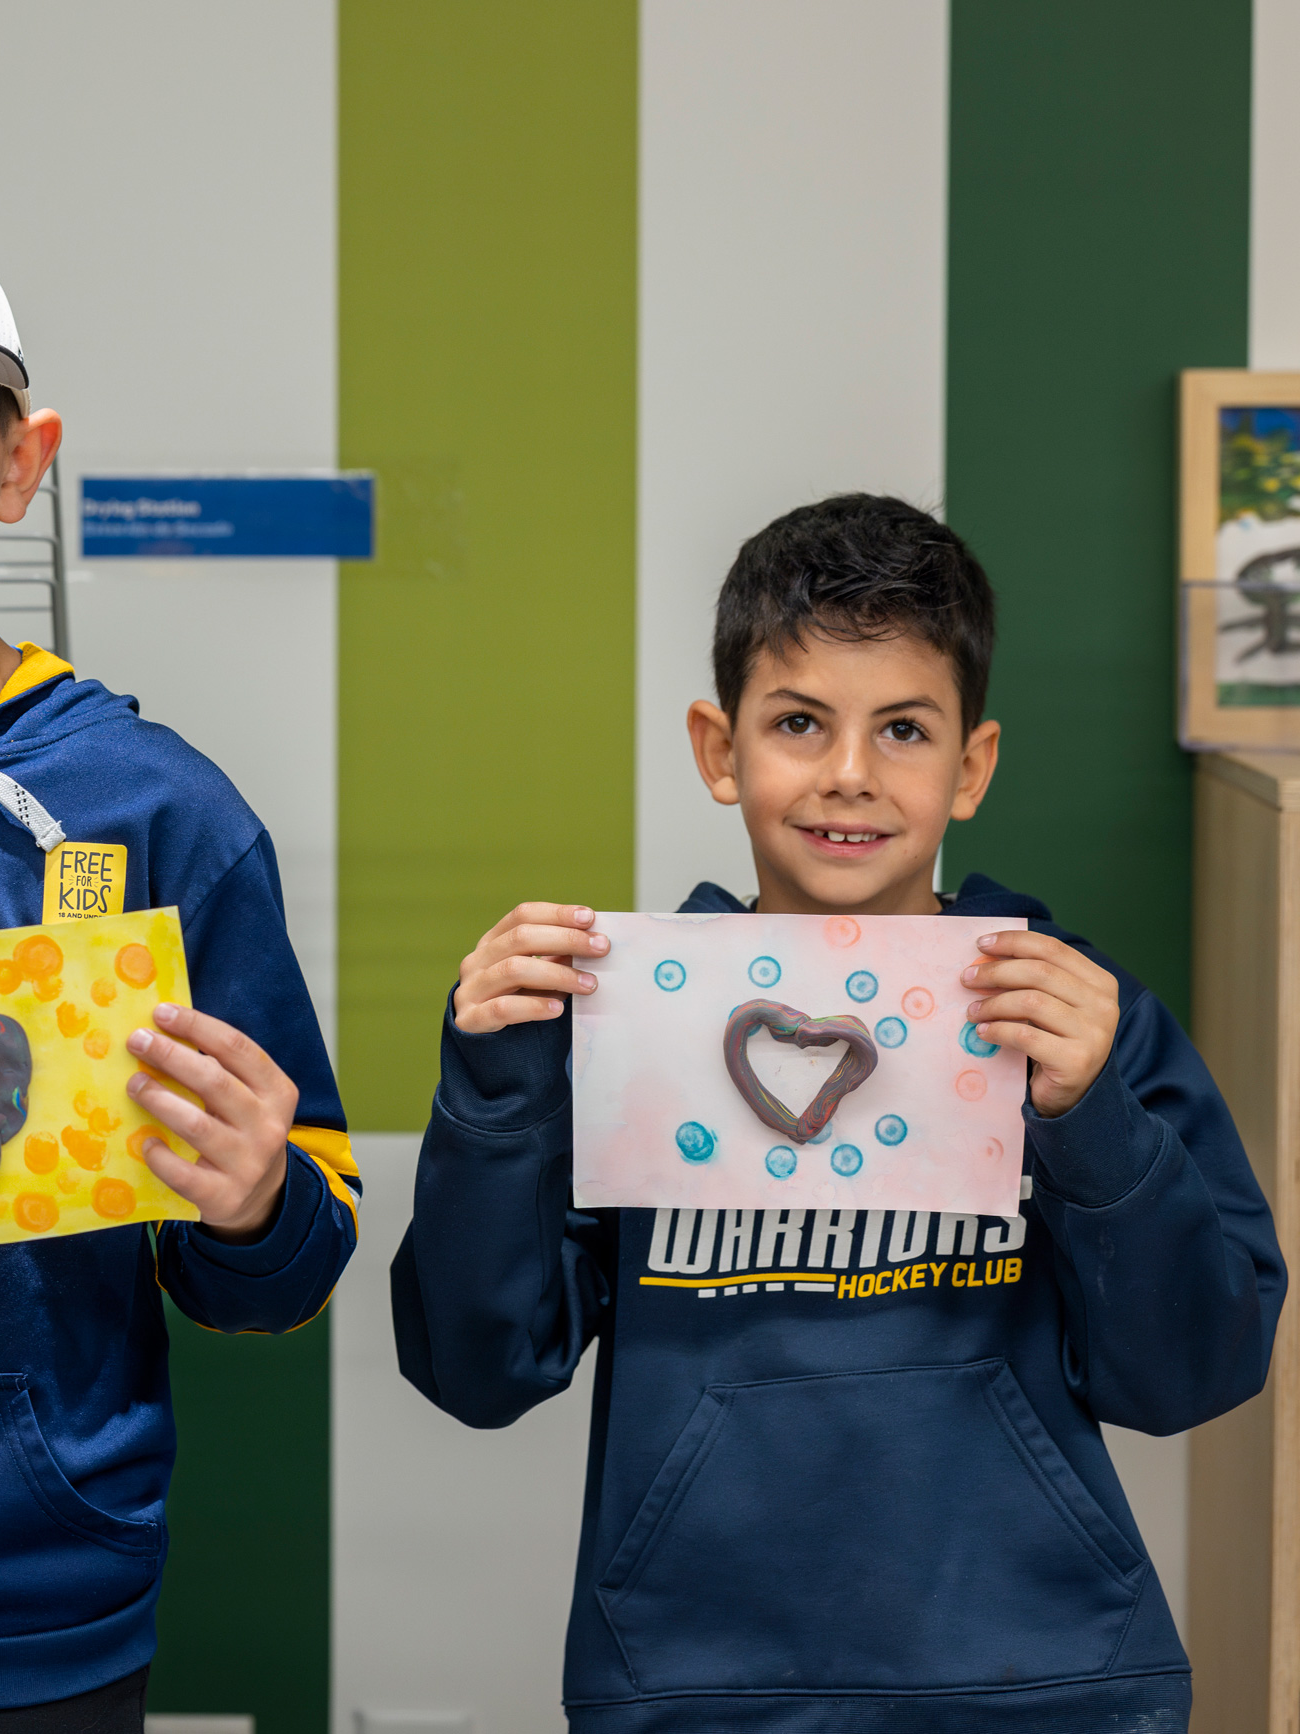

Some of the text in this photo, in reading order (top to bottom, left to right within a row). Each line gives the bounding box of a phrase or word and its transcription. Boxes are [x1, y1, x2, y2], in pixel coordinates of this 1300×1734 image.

[60, 851, 114, 882] FREE
[76, 875, 92, 887] FOR
[59, 882, 111, 913] KIDS
[837, 1258, 1023, 1299] HOCKEY CLUB
